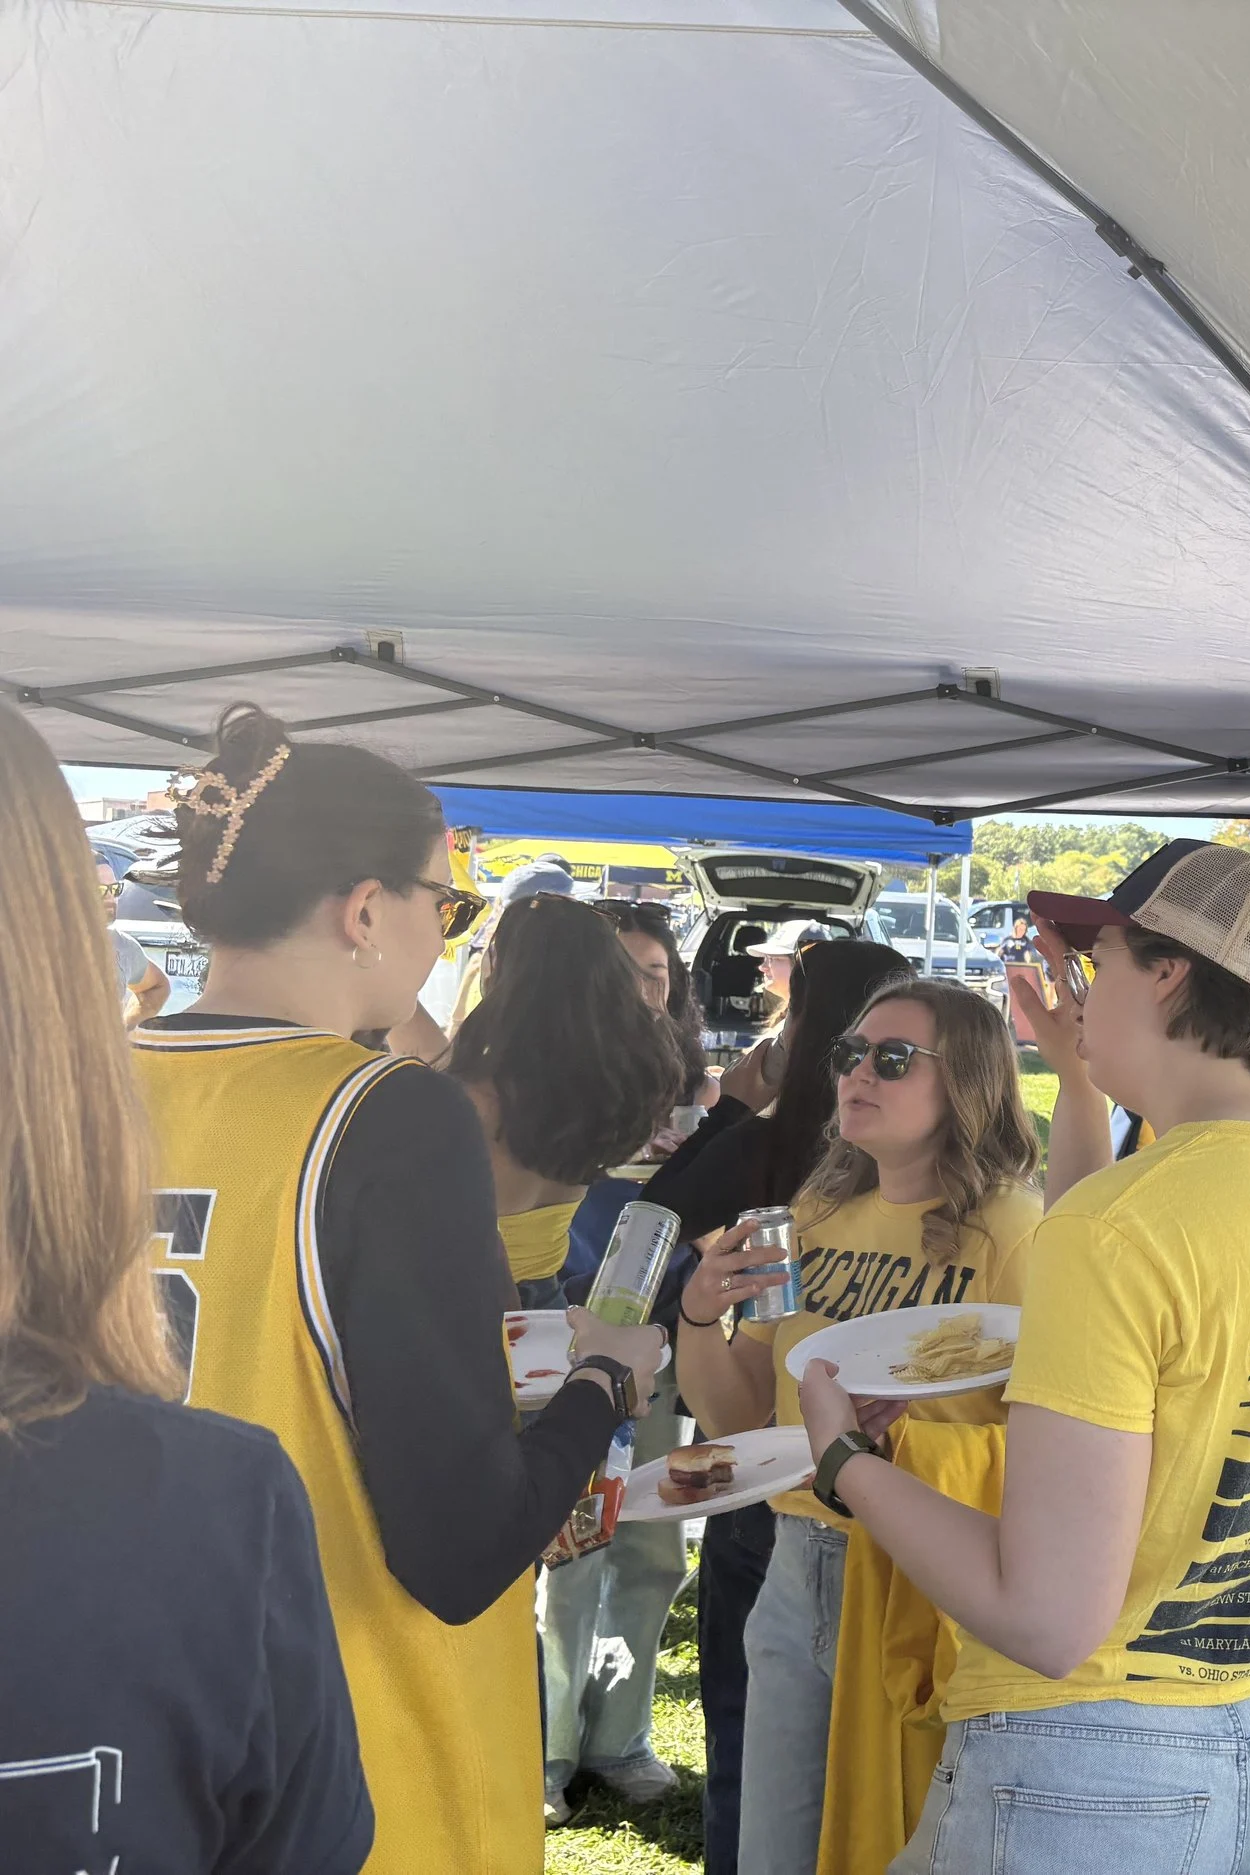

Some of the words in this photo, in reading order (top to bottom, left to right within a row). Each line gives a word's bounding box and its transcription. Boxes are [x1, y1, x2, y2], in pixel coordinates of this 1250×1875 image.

[571, 865, 601, 878] CHIGA
[666, 871, 682, 883] M
[1210, 1565, 1222, 1574] at
[1180, 1638, 1192, 1646] at
[1179, 1665, 1195, 1677] vs.
[1198, 1667, 1229, 1681] OHIO
